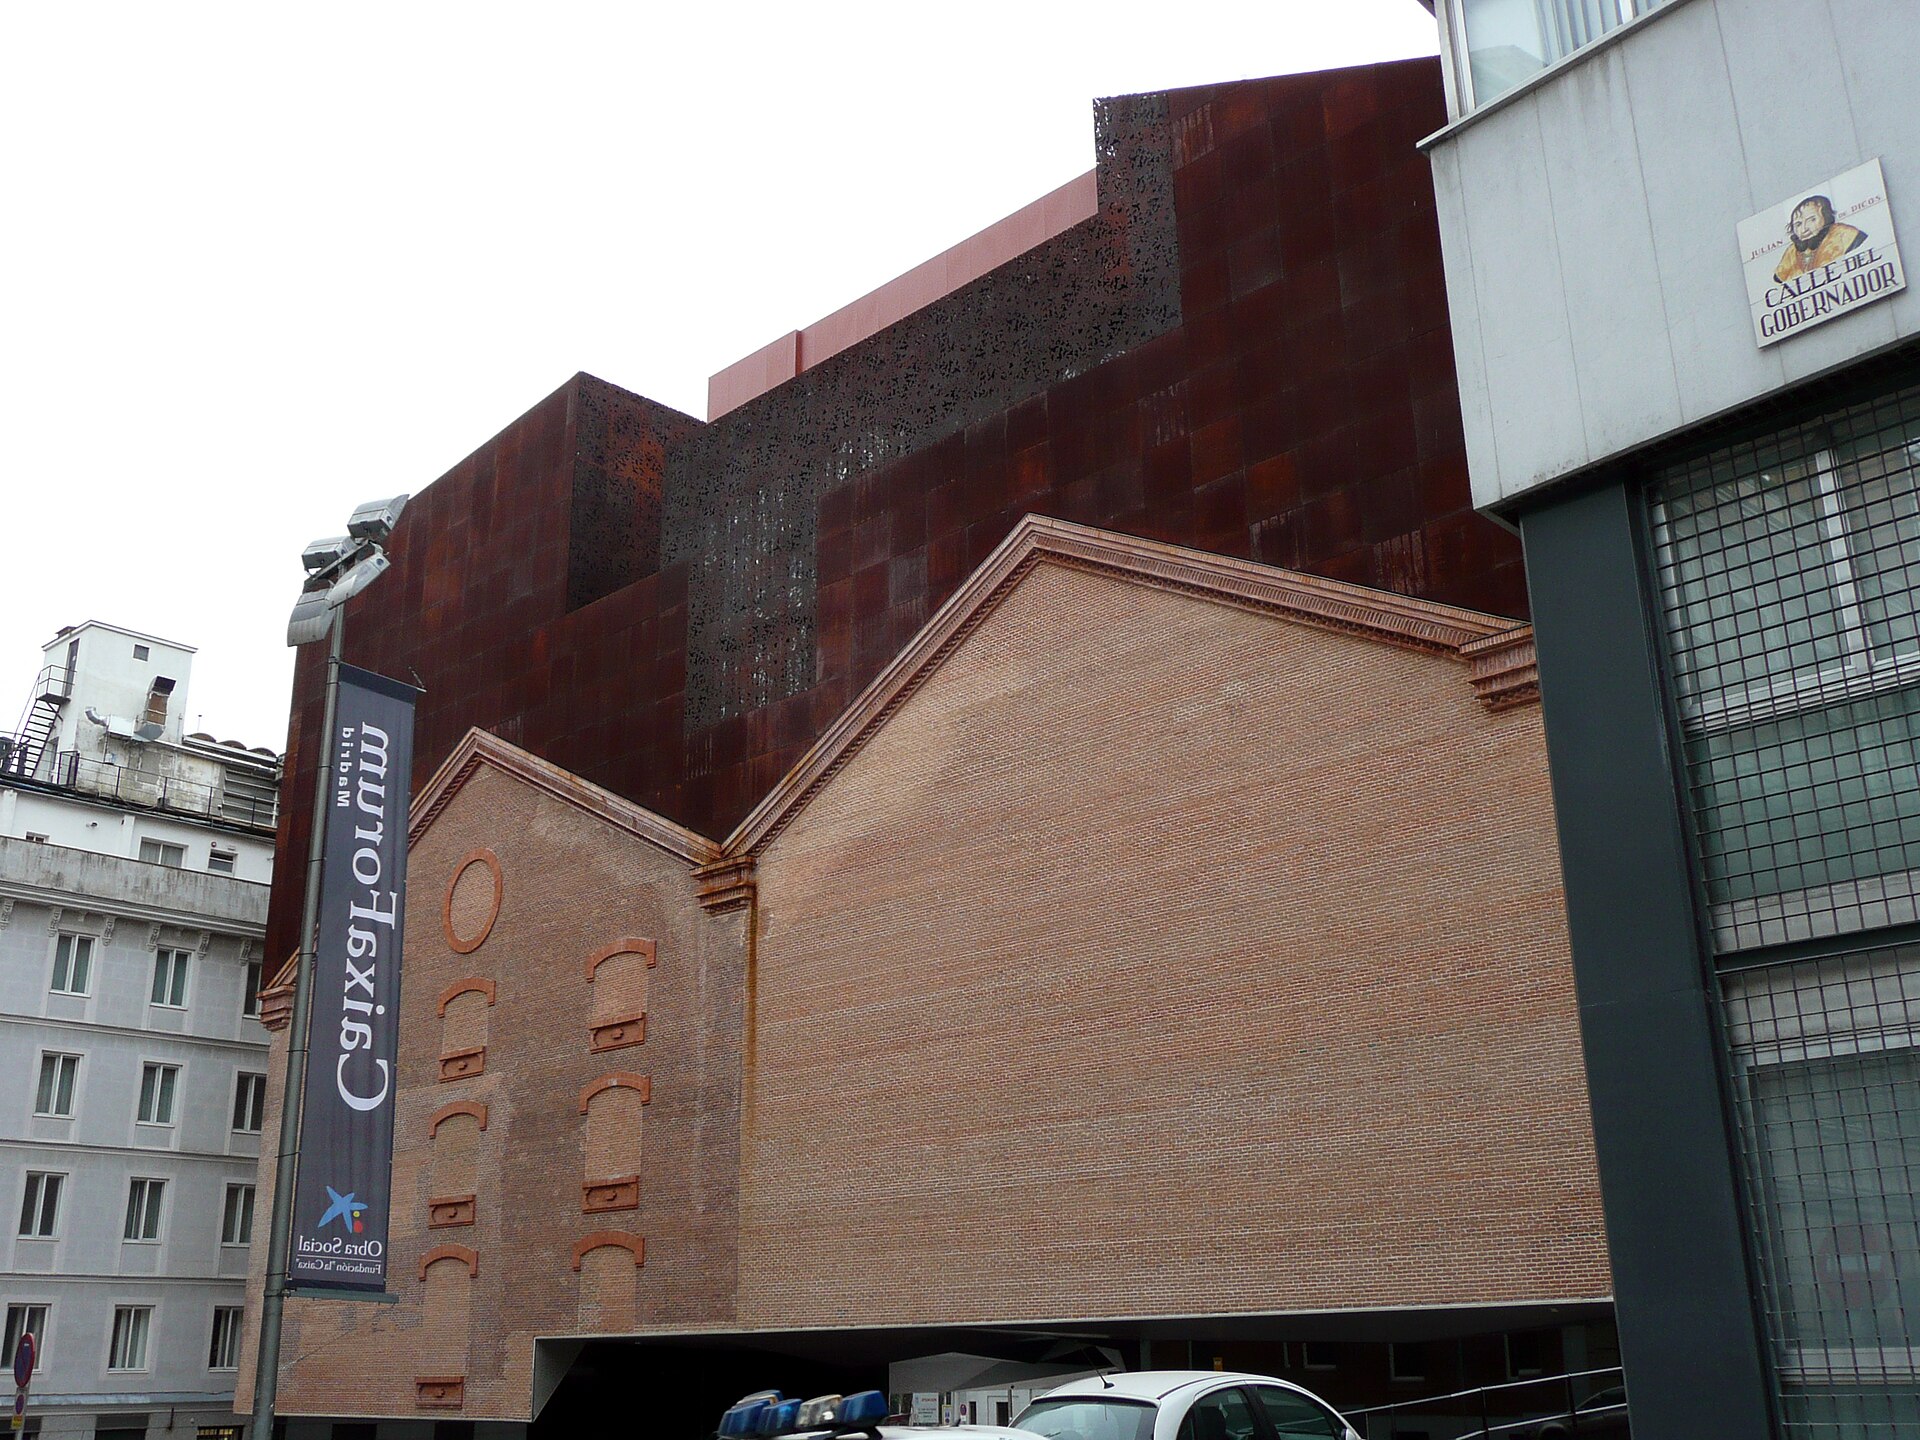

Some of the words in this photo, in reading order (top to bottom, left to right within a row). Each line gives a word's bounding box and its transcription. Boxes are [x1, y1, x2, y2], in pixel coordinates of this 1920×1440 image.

[1751, 240, 1784, 260] JULIAN
[1765, 261, 1842, 308] CALLE
[1844, 247, 1882, 274] DEL
[1760, 262, 1898, 338] GOBERNADOR
